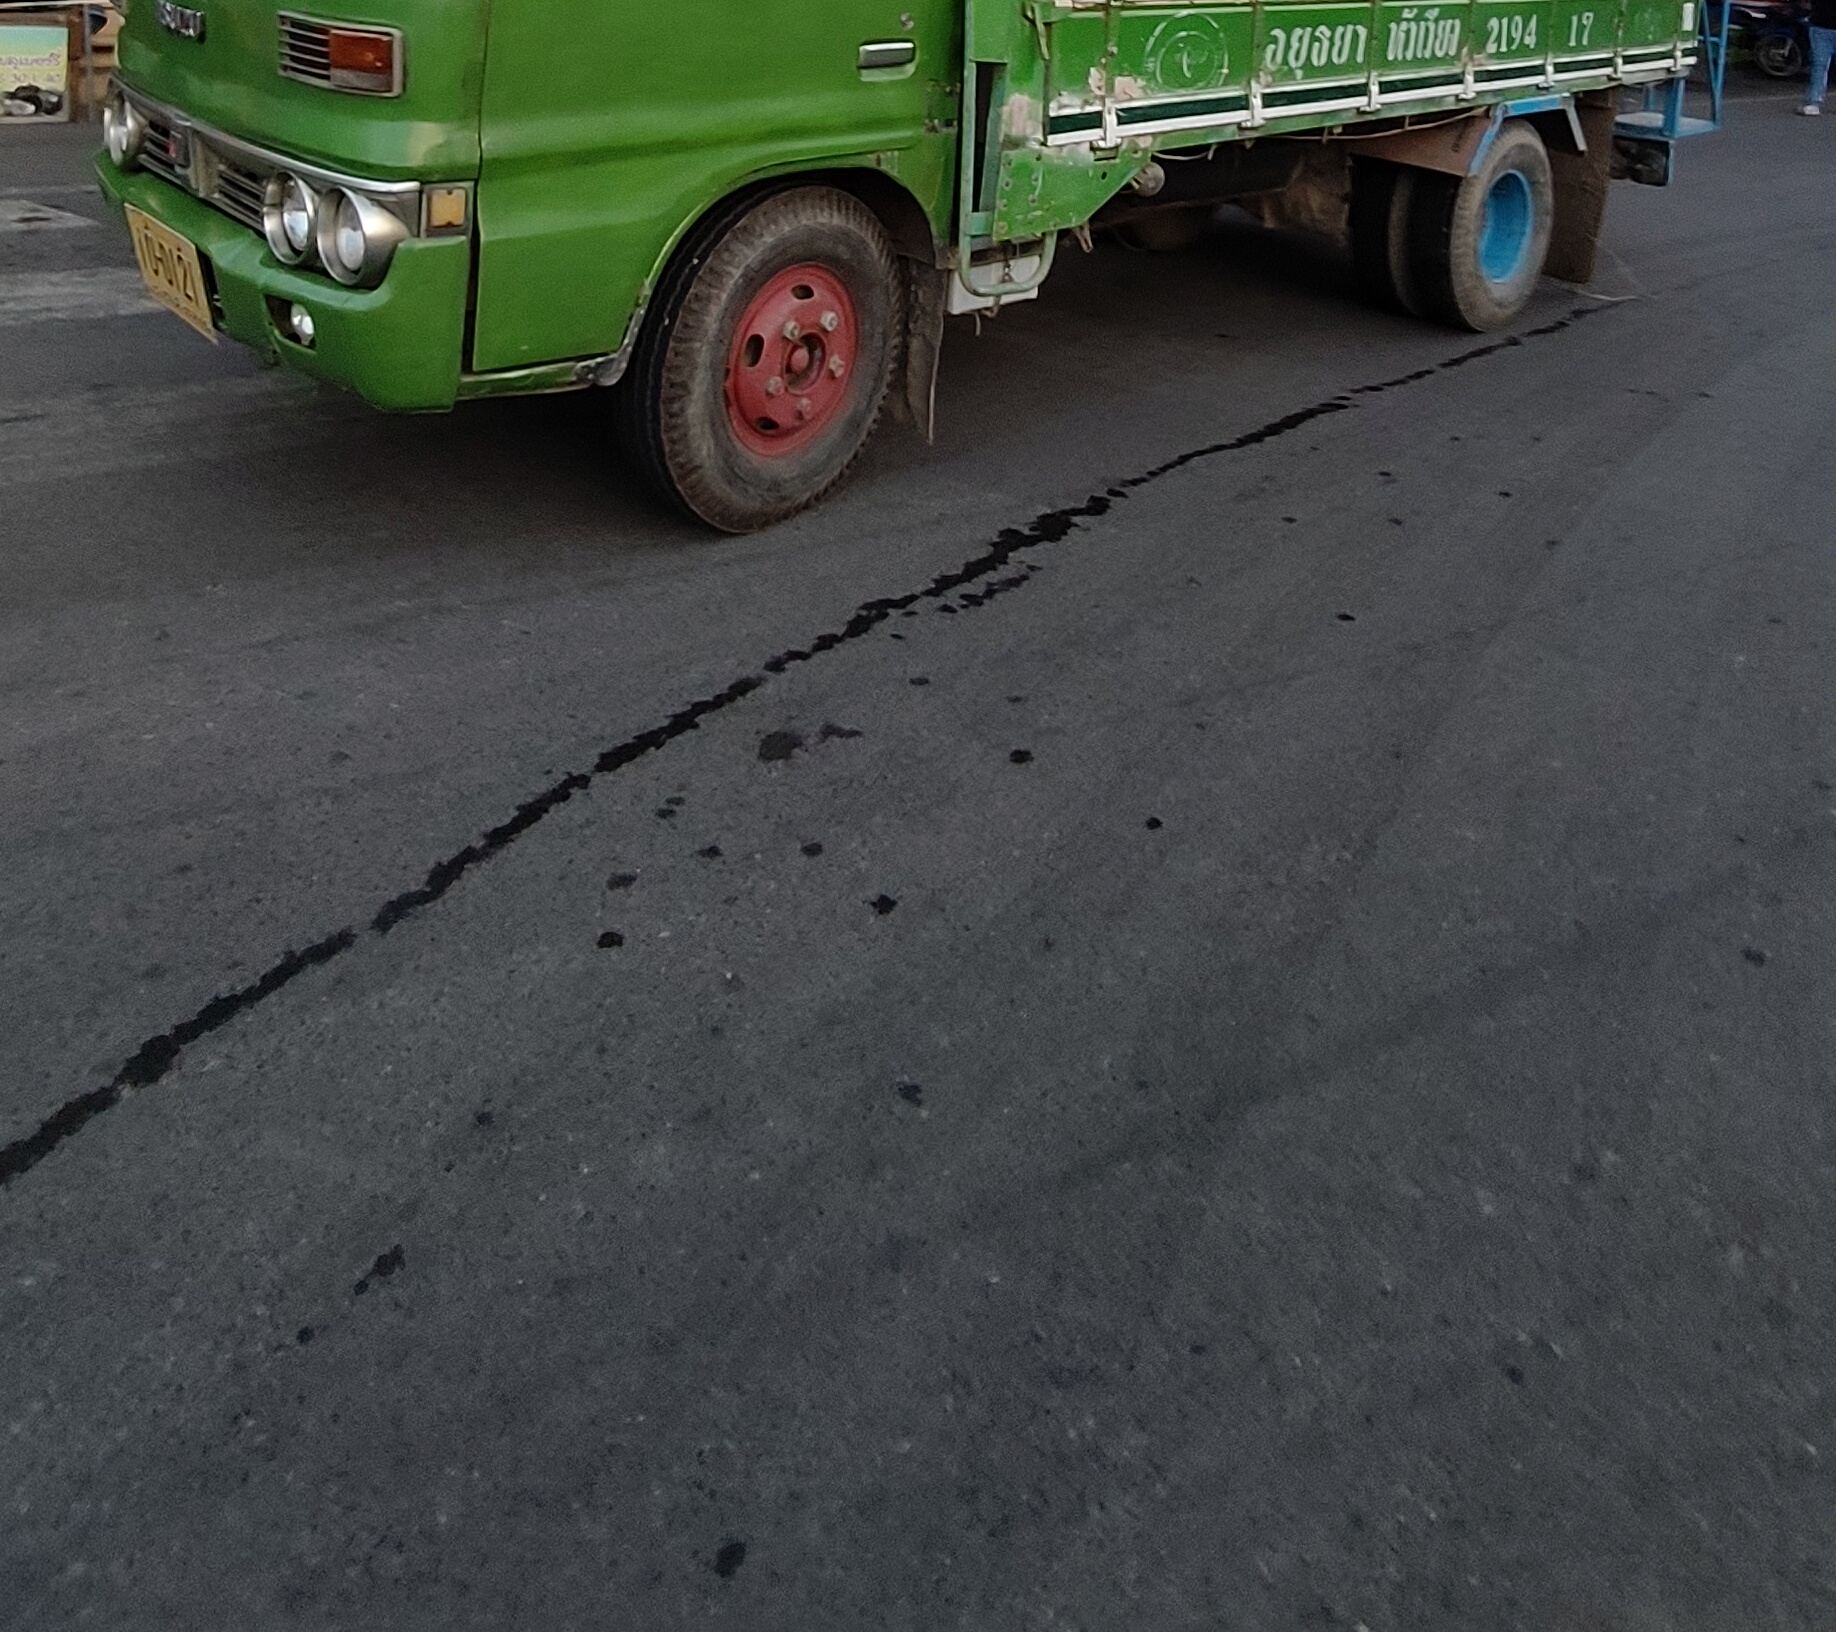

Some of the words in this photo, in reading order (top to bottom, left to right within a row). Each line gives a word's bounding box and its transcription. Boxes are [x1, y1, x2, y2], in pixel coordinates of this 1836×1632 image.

[1265, 24, 1368, 80] อยุธยา
[1486, 14, 1537, 54] 2194
